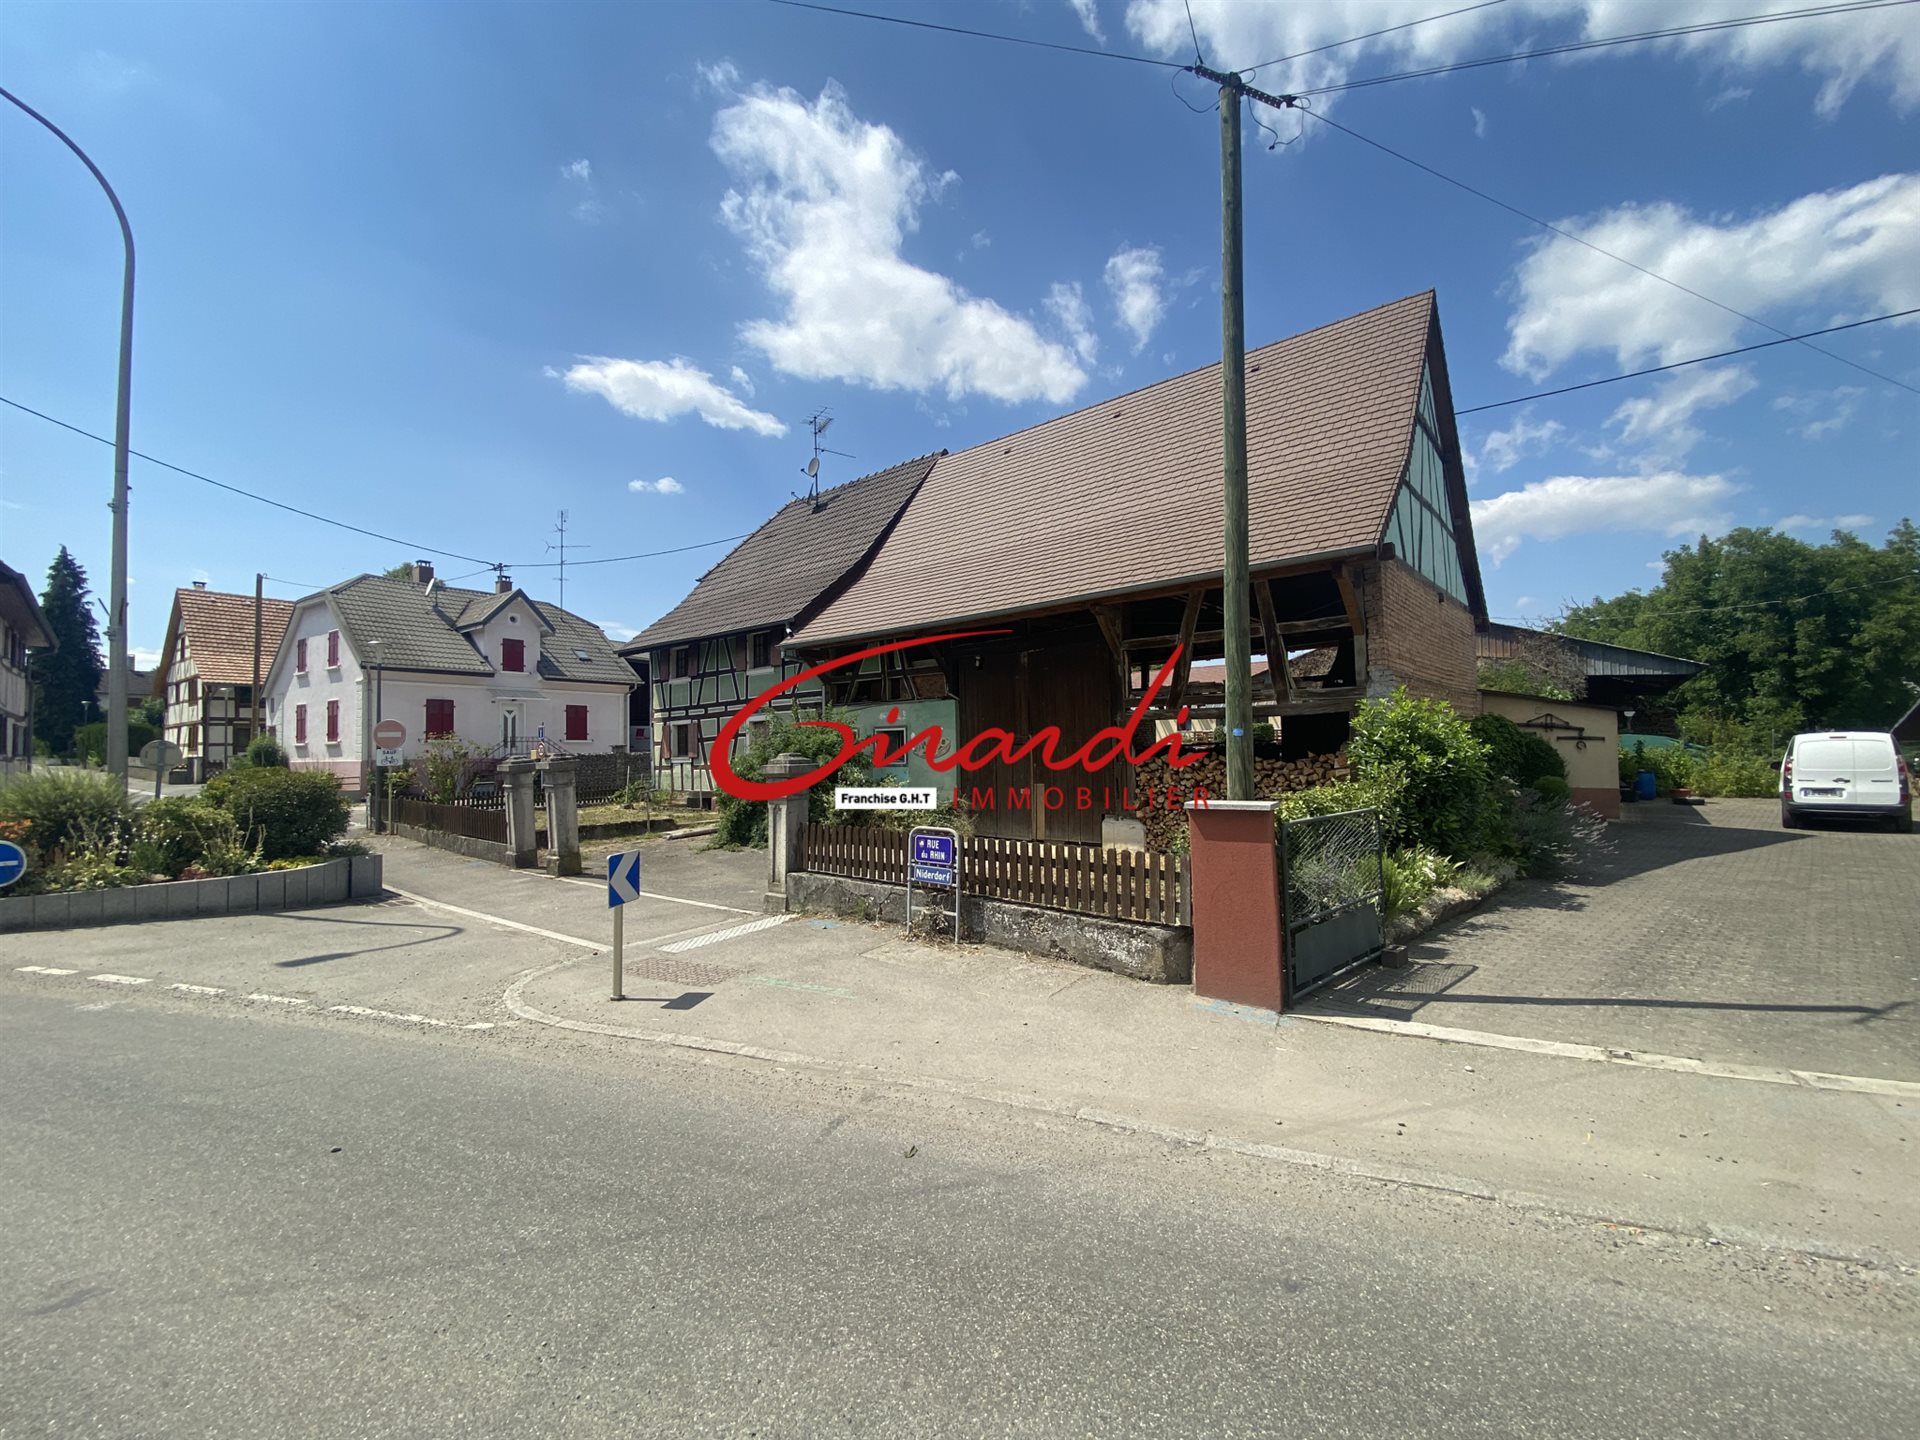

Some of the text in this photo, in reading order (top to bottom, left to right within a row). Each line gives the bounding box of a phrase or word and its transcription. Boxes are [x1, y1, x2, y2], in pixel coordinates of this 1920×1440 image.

[927, 839, 940, 849] RUE
[921, 850, 945, 860] du RHIN
[916, 868, 951, 881] Niderdorf
